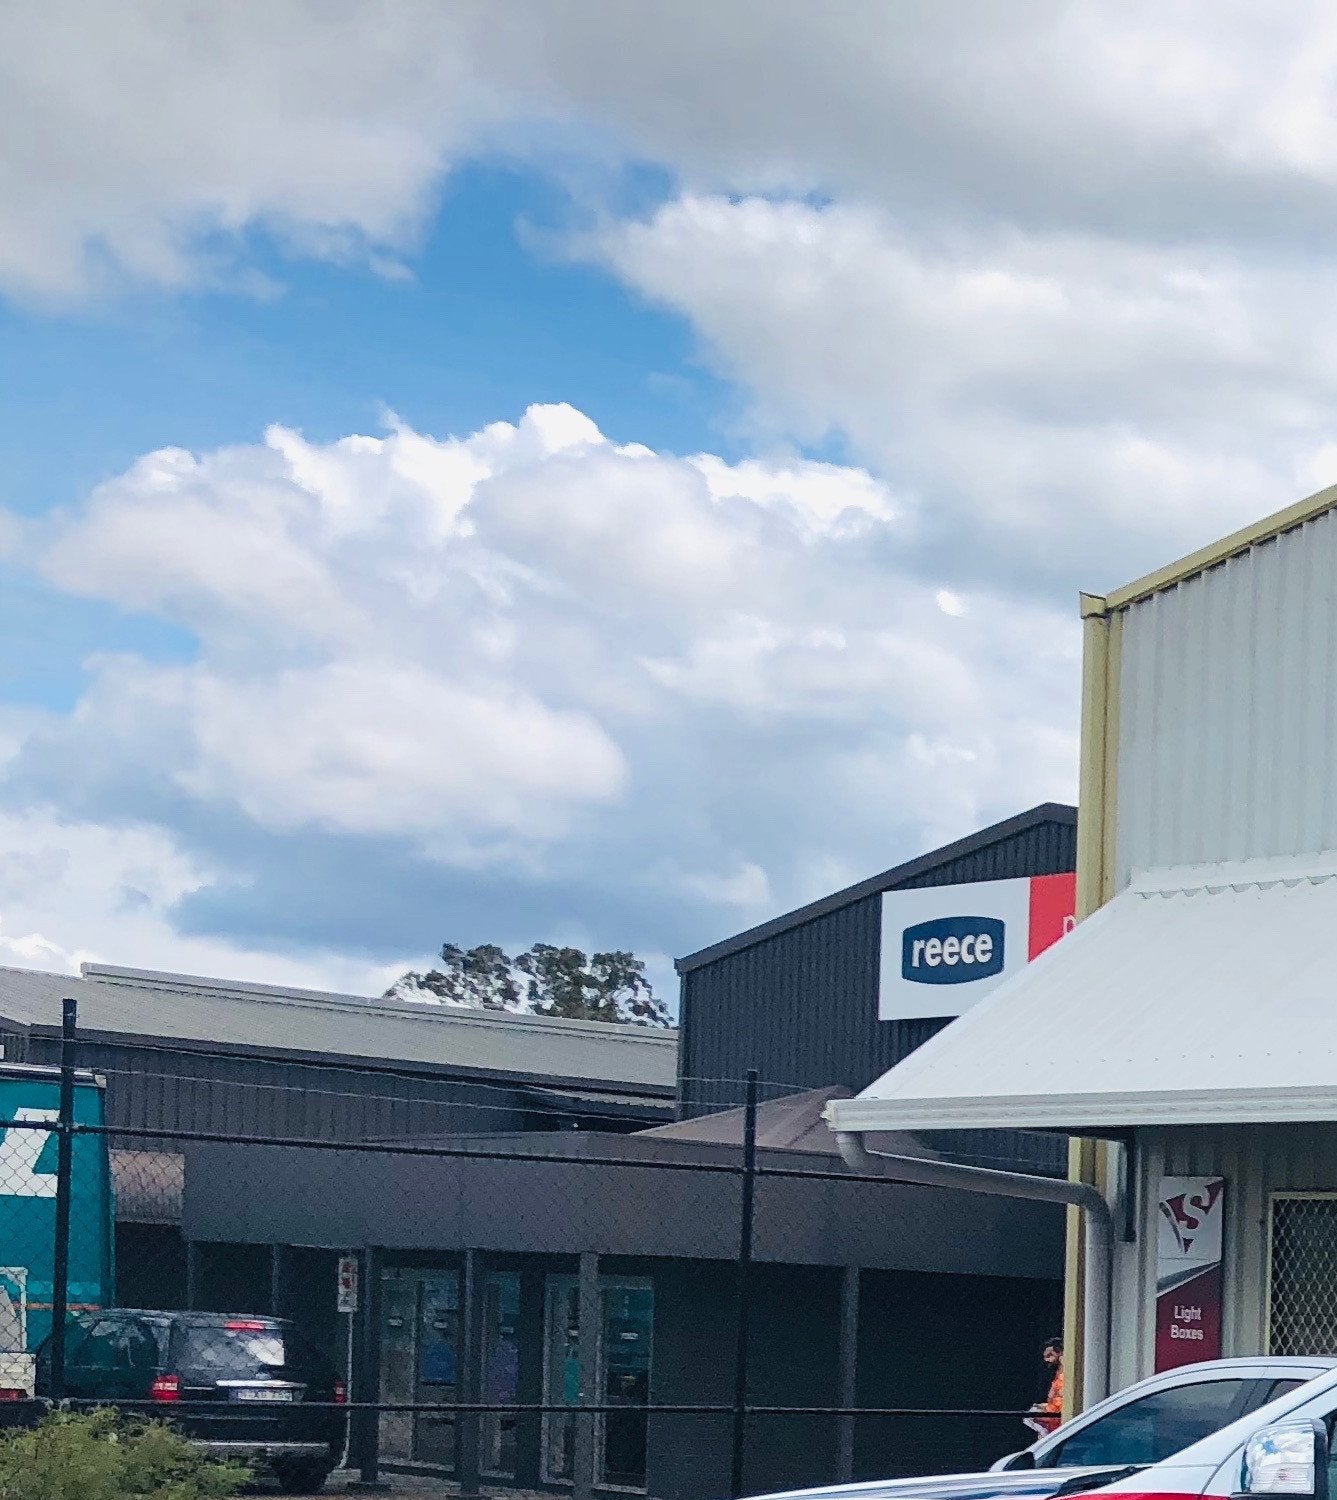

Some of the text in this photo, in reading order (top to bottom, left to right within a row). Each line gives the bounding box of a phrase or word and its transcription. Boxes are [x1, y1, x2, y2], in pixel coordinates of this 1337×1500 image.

[911, 932, 993, 968] reece
[1174, 1305, 1202, 1323] Light
[1170, 1324, 1204, 1340] Boxes
